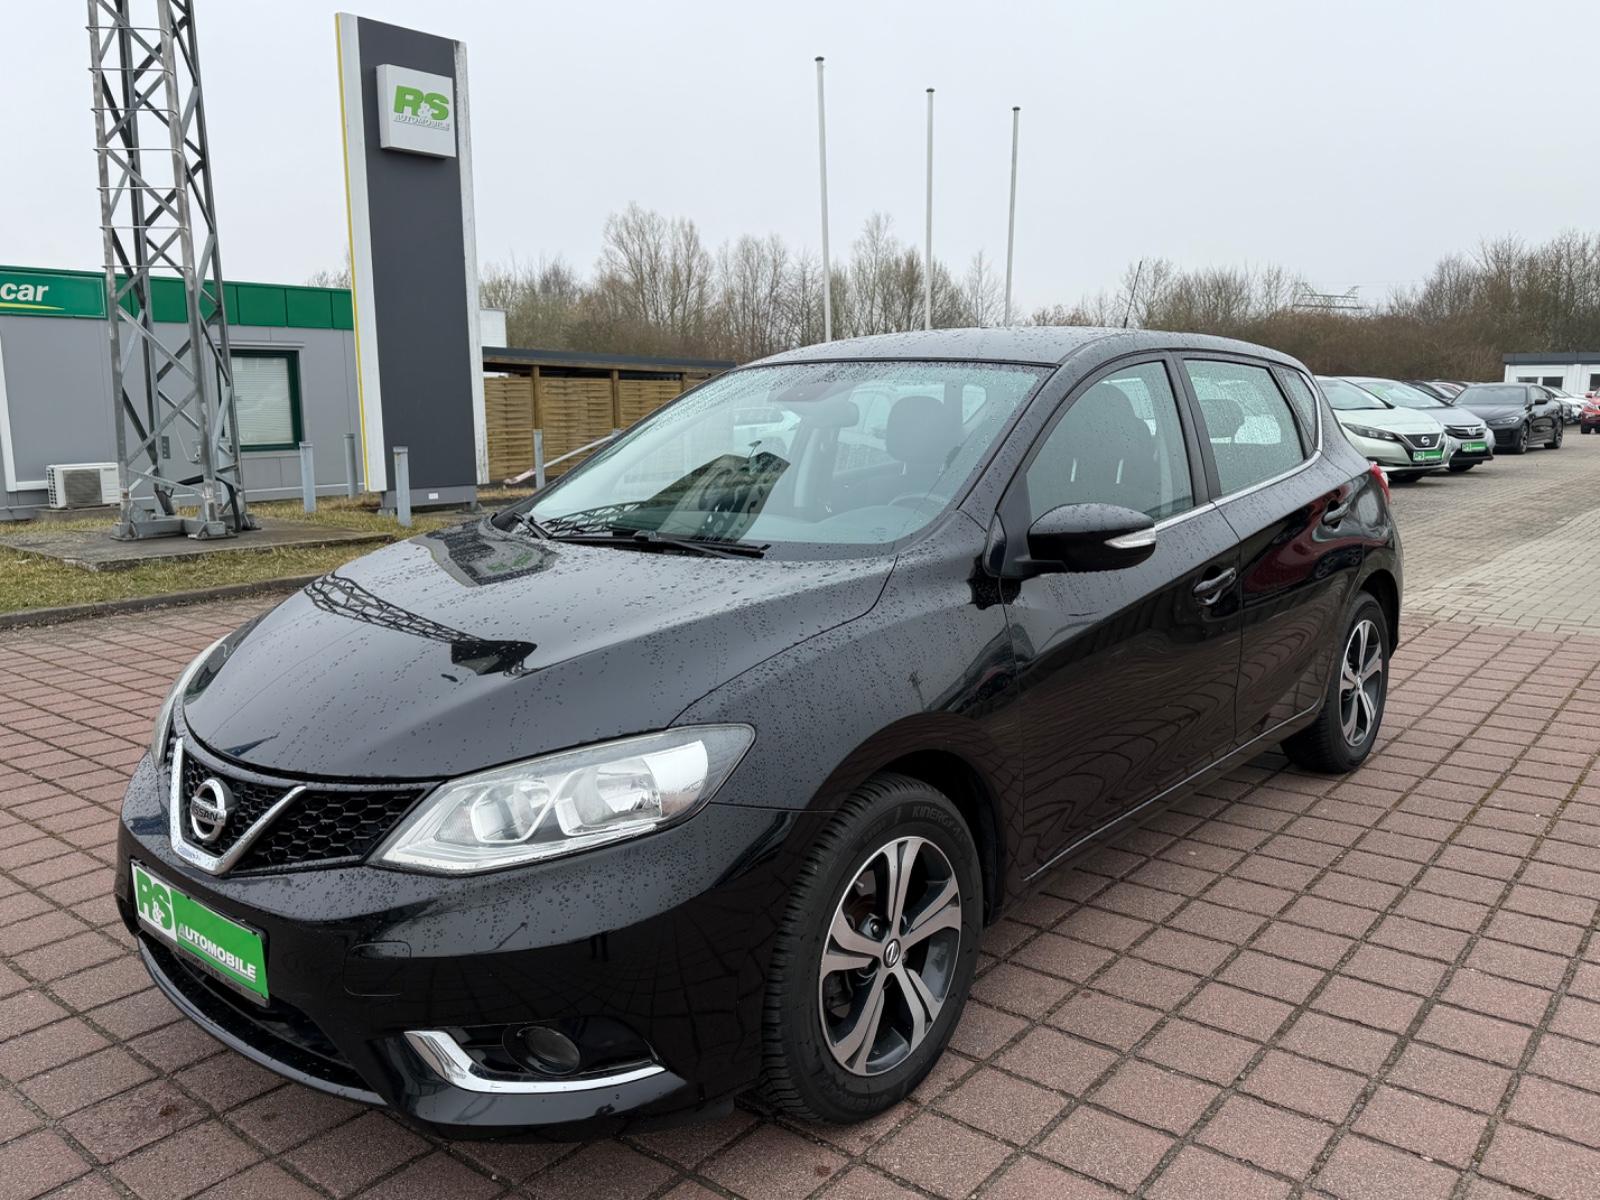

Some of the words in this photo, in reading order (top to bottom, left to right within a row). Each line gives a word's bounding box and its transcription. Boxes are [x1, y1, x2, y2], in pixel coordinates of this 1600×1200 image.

[393, 85, 450, 121] R&S
[0, 282, 49, 302] car
[136, 867, 173, 931] R&S
[177, 922, 257, 980] AUTOMOBILE
